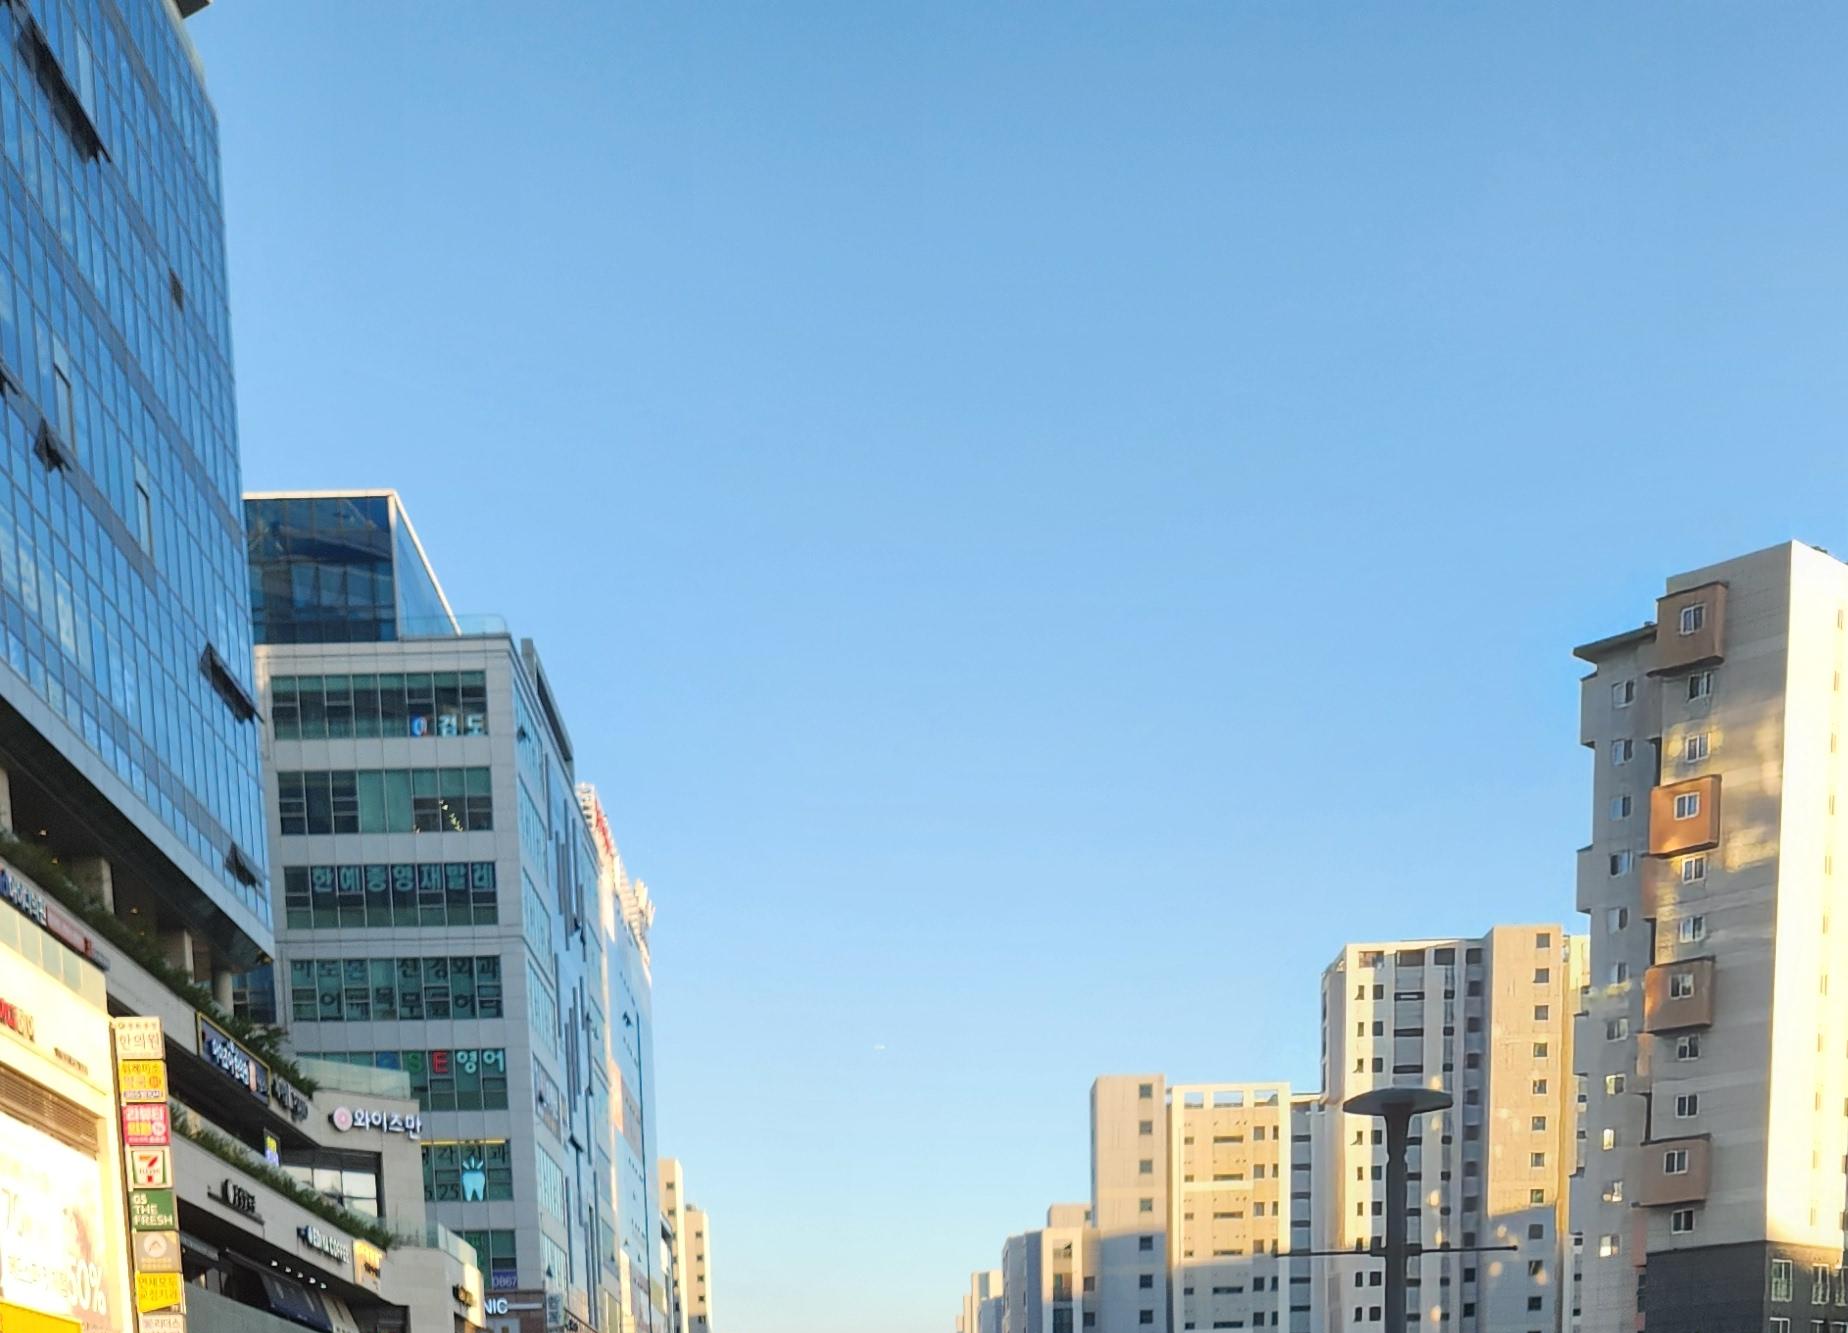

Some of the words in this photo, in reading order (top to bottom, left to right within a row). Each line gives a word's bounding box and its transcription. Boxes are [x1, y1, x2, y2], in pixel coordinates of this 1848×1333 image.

[353, 1107, 422, 1140] 와이즈만
[133, 1193, 147, 1205] GS
[135, 1204, 158, 1215] THE
[134, 1215, 173, 1226] FRESH
